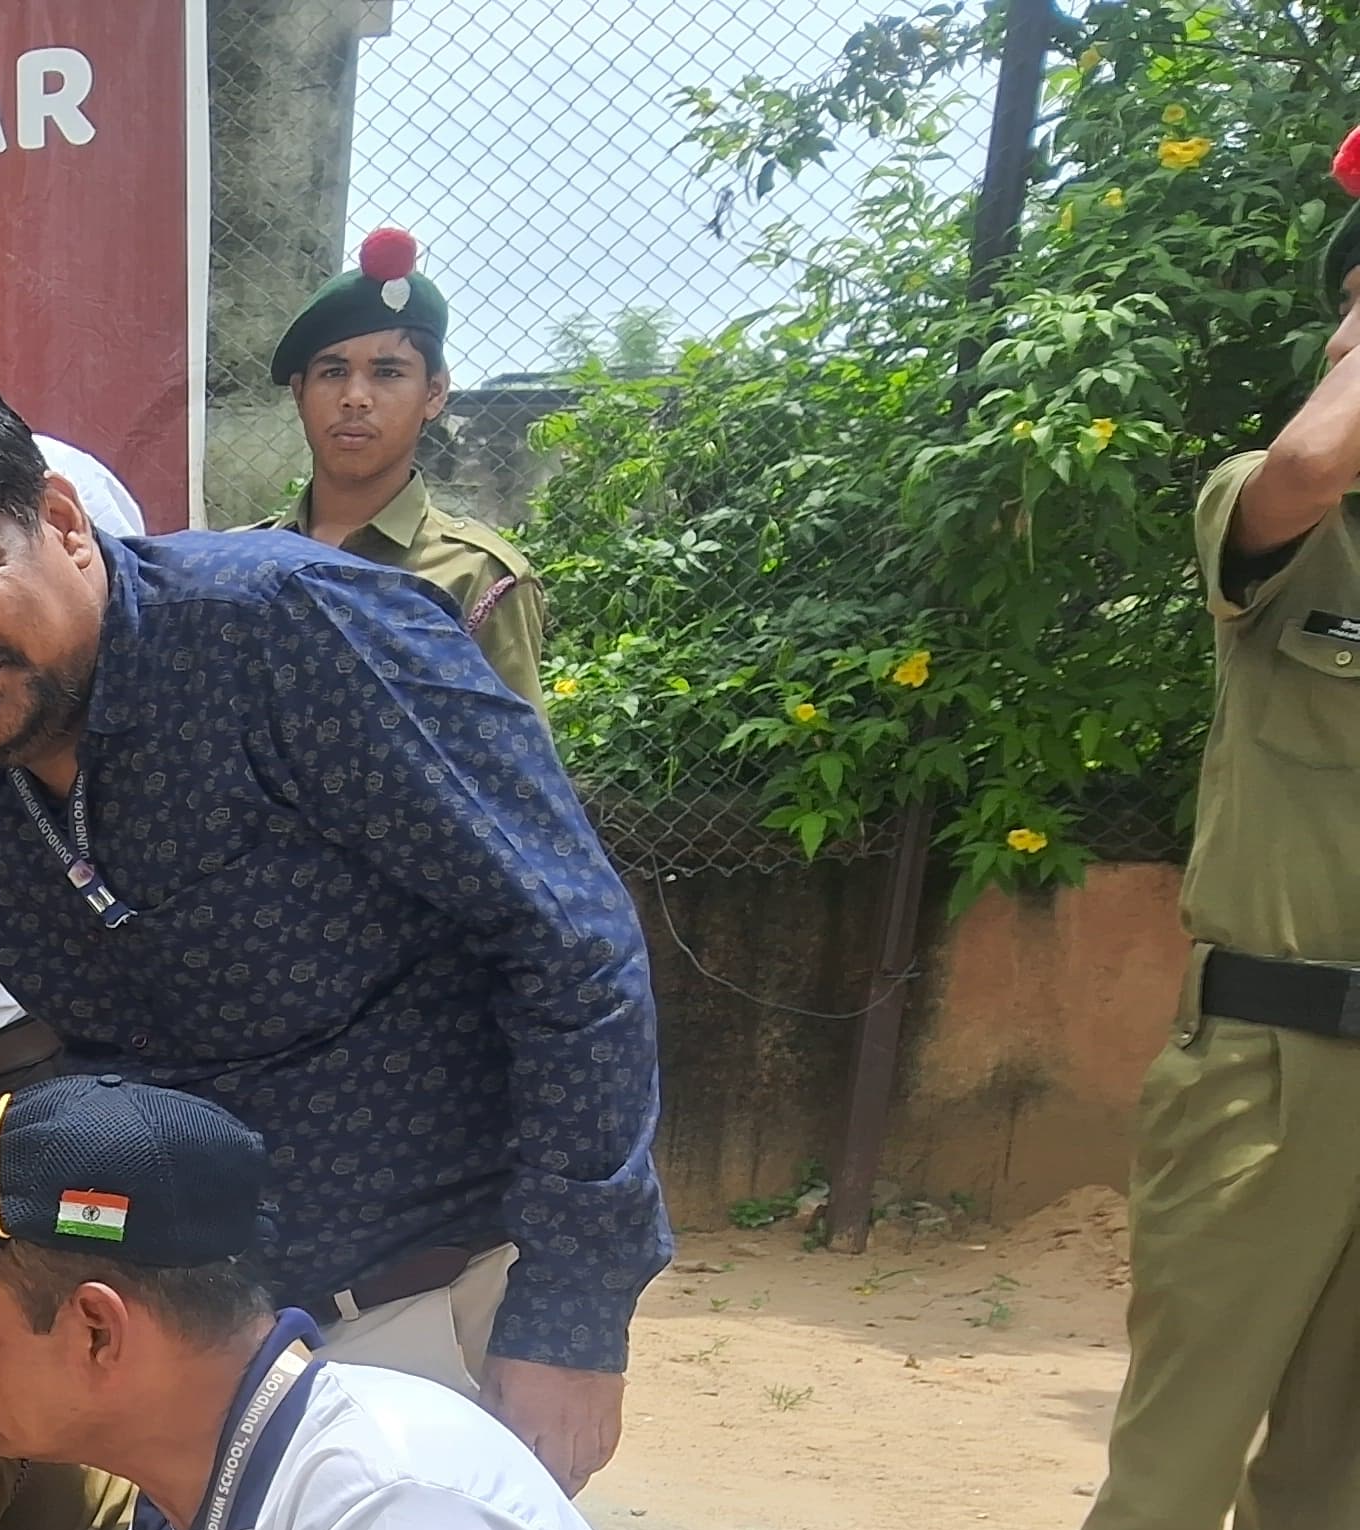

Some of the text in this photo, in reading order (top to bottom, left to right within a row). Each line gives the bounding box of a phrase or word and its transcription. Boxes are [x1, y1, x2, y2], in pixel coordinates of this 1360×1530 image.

[38, 817, 73, 865] DUNDLOD
[74, 801, 89, 858] DUNDLOD
[218, 1437, 251, 1495] SCHOOL,
[241, 1373, 284, 1434] DUNDLOD
